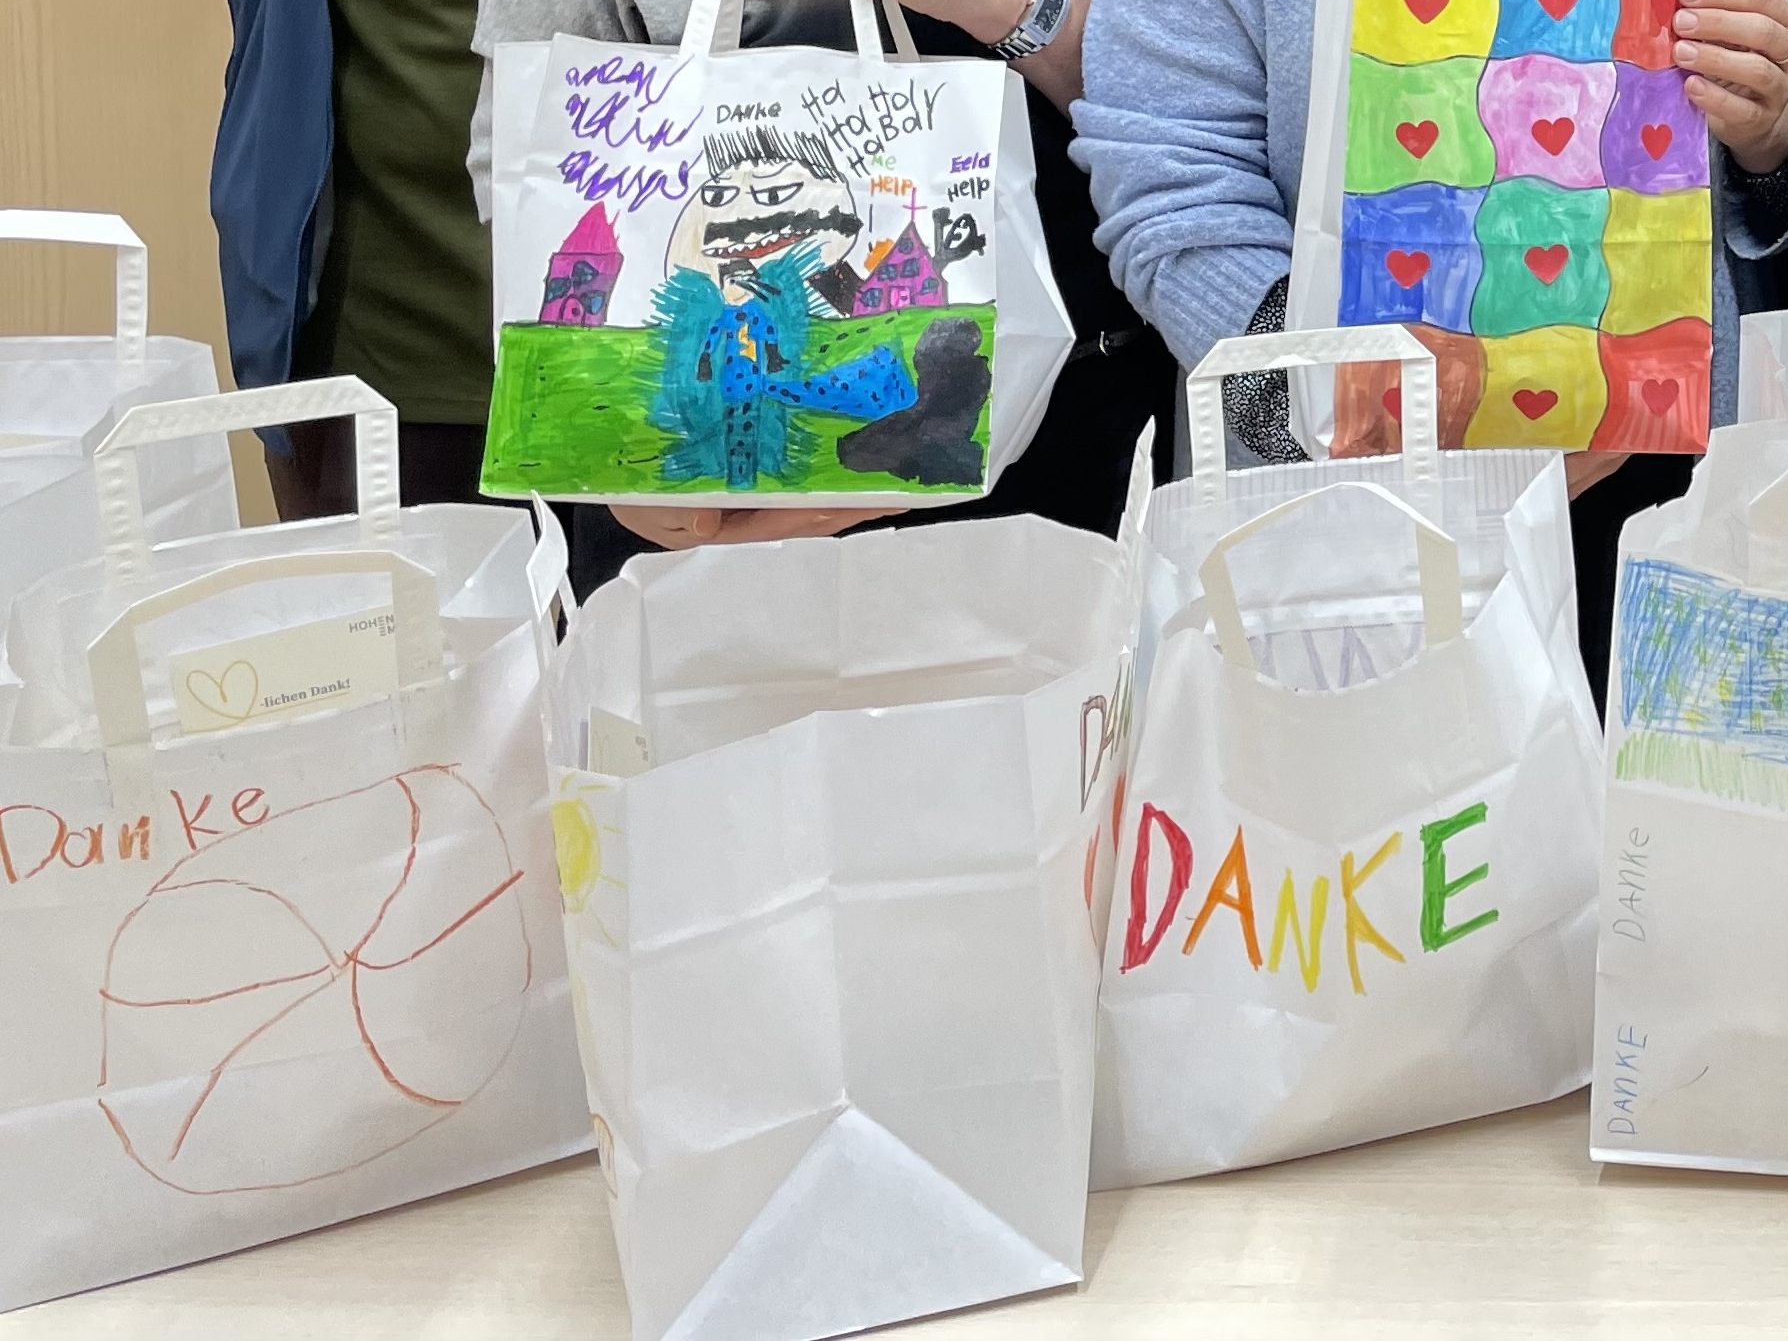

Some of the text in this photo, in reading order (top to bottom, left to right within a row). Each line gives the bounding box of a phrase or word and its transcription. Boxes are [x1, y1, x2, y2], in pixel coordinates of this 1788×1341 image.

[311, 677, 351, 696] Dank!
[0, 788, 270, 884] Danke
[1119, 801, 1500, 996] DANKE
